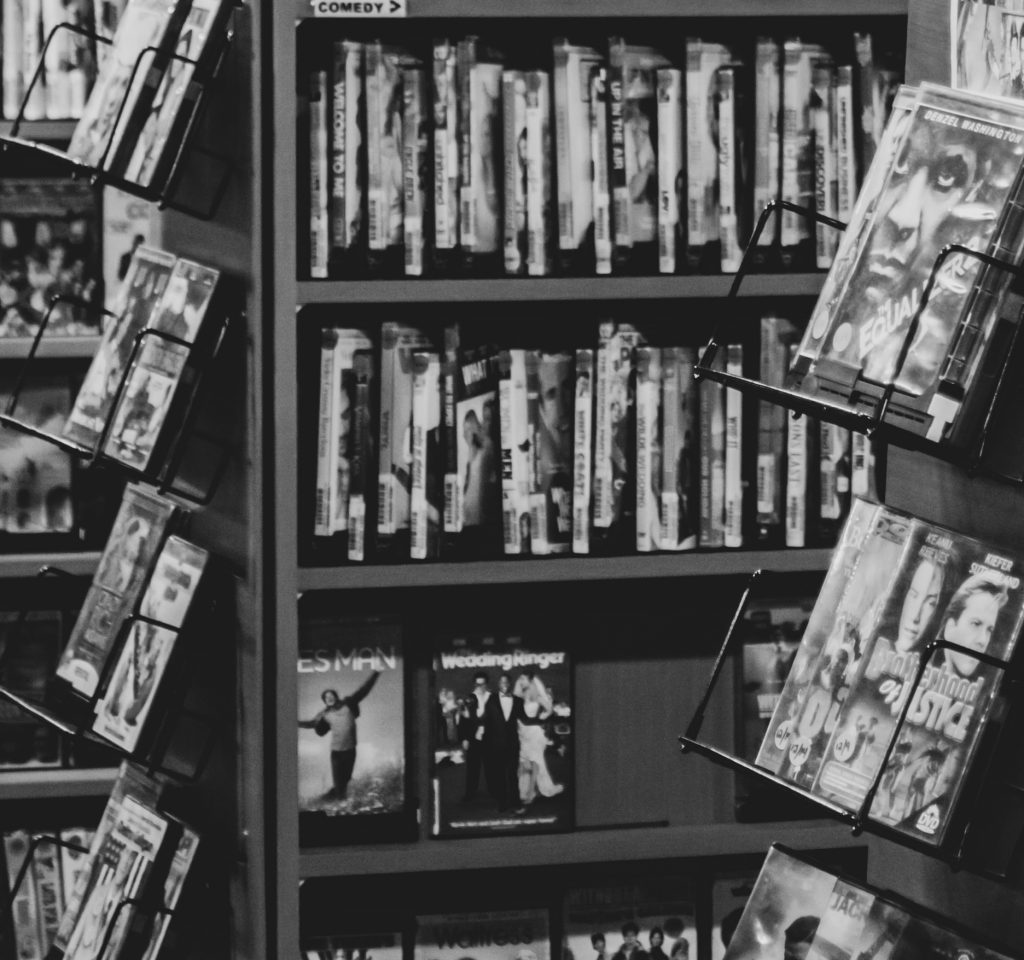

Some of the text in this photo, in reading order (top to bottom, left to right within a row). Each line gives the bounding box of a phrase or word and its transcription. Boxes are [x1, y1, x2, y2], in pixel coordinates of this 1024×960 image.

[318, 0, 384, 14] COMEDY
[611, 81, 623, 170] UP IN THE AIR
[924, 109, 1023, 144] DENZEL WASHINGTON
[333, 81, 345, 198] WELCOME TO ME
[984, 552, 1014, 572] KIEFER
[332, 646, 396, 672] MAN
[441, 651, 566, 671] Wedding Ringer
[919, 814, 939, 829] DVD
